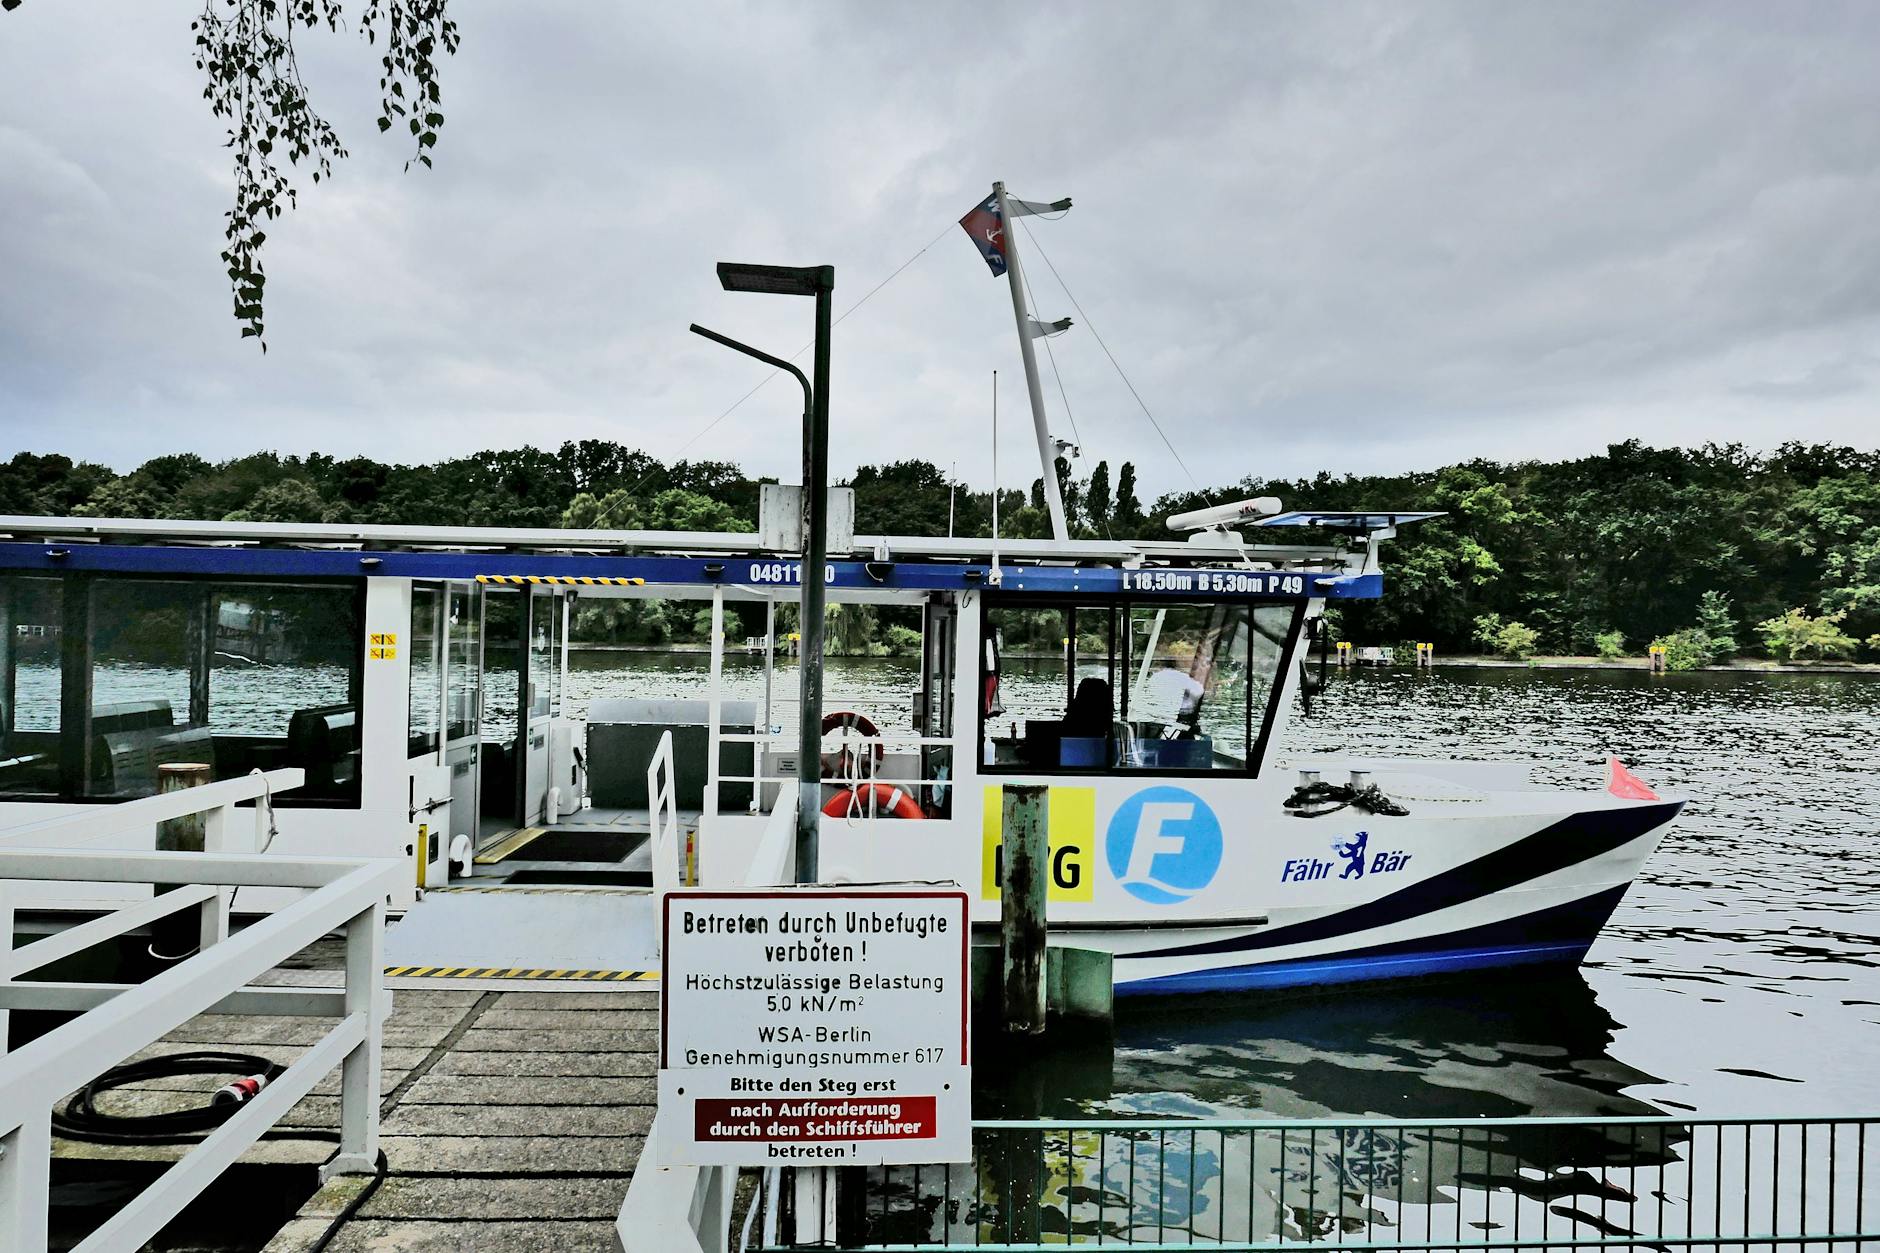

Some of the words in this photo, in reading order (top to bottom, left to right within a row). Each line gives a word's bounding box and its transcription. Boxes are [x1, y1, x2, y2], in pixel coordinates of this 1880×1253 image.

[750, 564, 834, 583] 048110
[1123, 573, 1131, 589] L
[1134, 572, 1192, 591] 18,50m
[1199, 574, 1209, 590] B
[1213, 574, 1262, 592] 5,30m
[1269, 576, 1279, 592] P
[1282, 577, 1302, 593] 49
[1125, 802, 1194, 878] F
[1282, 859, 1334, 882] Fähr
[1370, 851, 1412, 873] Bär
[684, 912, 768, 934] Betreten
[779, 912, 835, 933] durch
[847, 912, 946, 938] Unbefugte
[765, 940, 852, 962] verboten
[687, 974, 840, 993] Höchstzulässige
[850, 974, 942, 993] Belastung
[768, 995, 791, 1012] 5,0
[801, 995, 864, 1012] kN/m²
[759, 1027, 870, 1042] WSA-Berlin
[686, 1050, 909, 1068] Genehmigungsnummer
[916, 1048, 944, 1064] 617
[731, 1078, 773, 1091] Bitte
[780, 1078, 811, 1091] den
[819, 1078, 856, 1095] Steg
[864, 1080, 896, 1091] erst
[731, 1103, 772, 1116] nach
[779, 1102, 900, 1118] Aufforderung
[710, 1122, 760, 1136] durch
[767, 1122, 799, 1136] den
[807, 1119, 921, 1135] Schiffsführer
[768, 1144, 845, 1158] betreten
